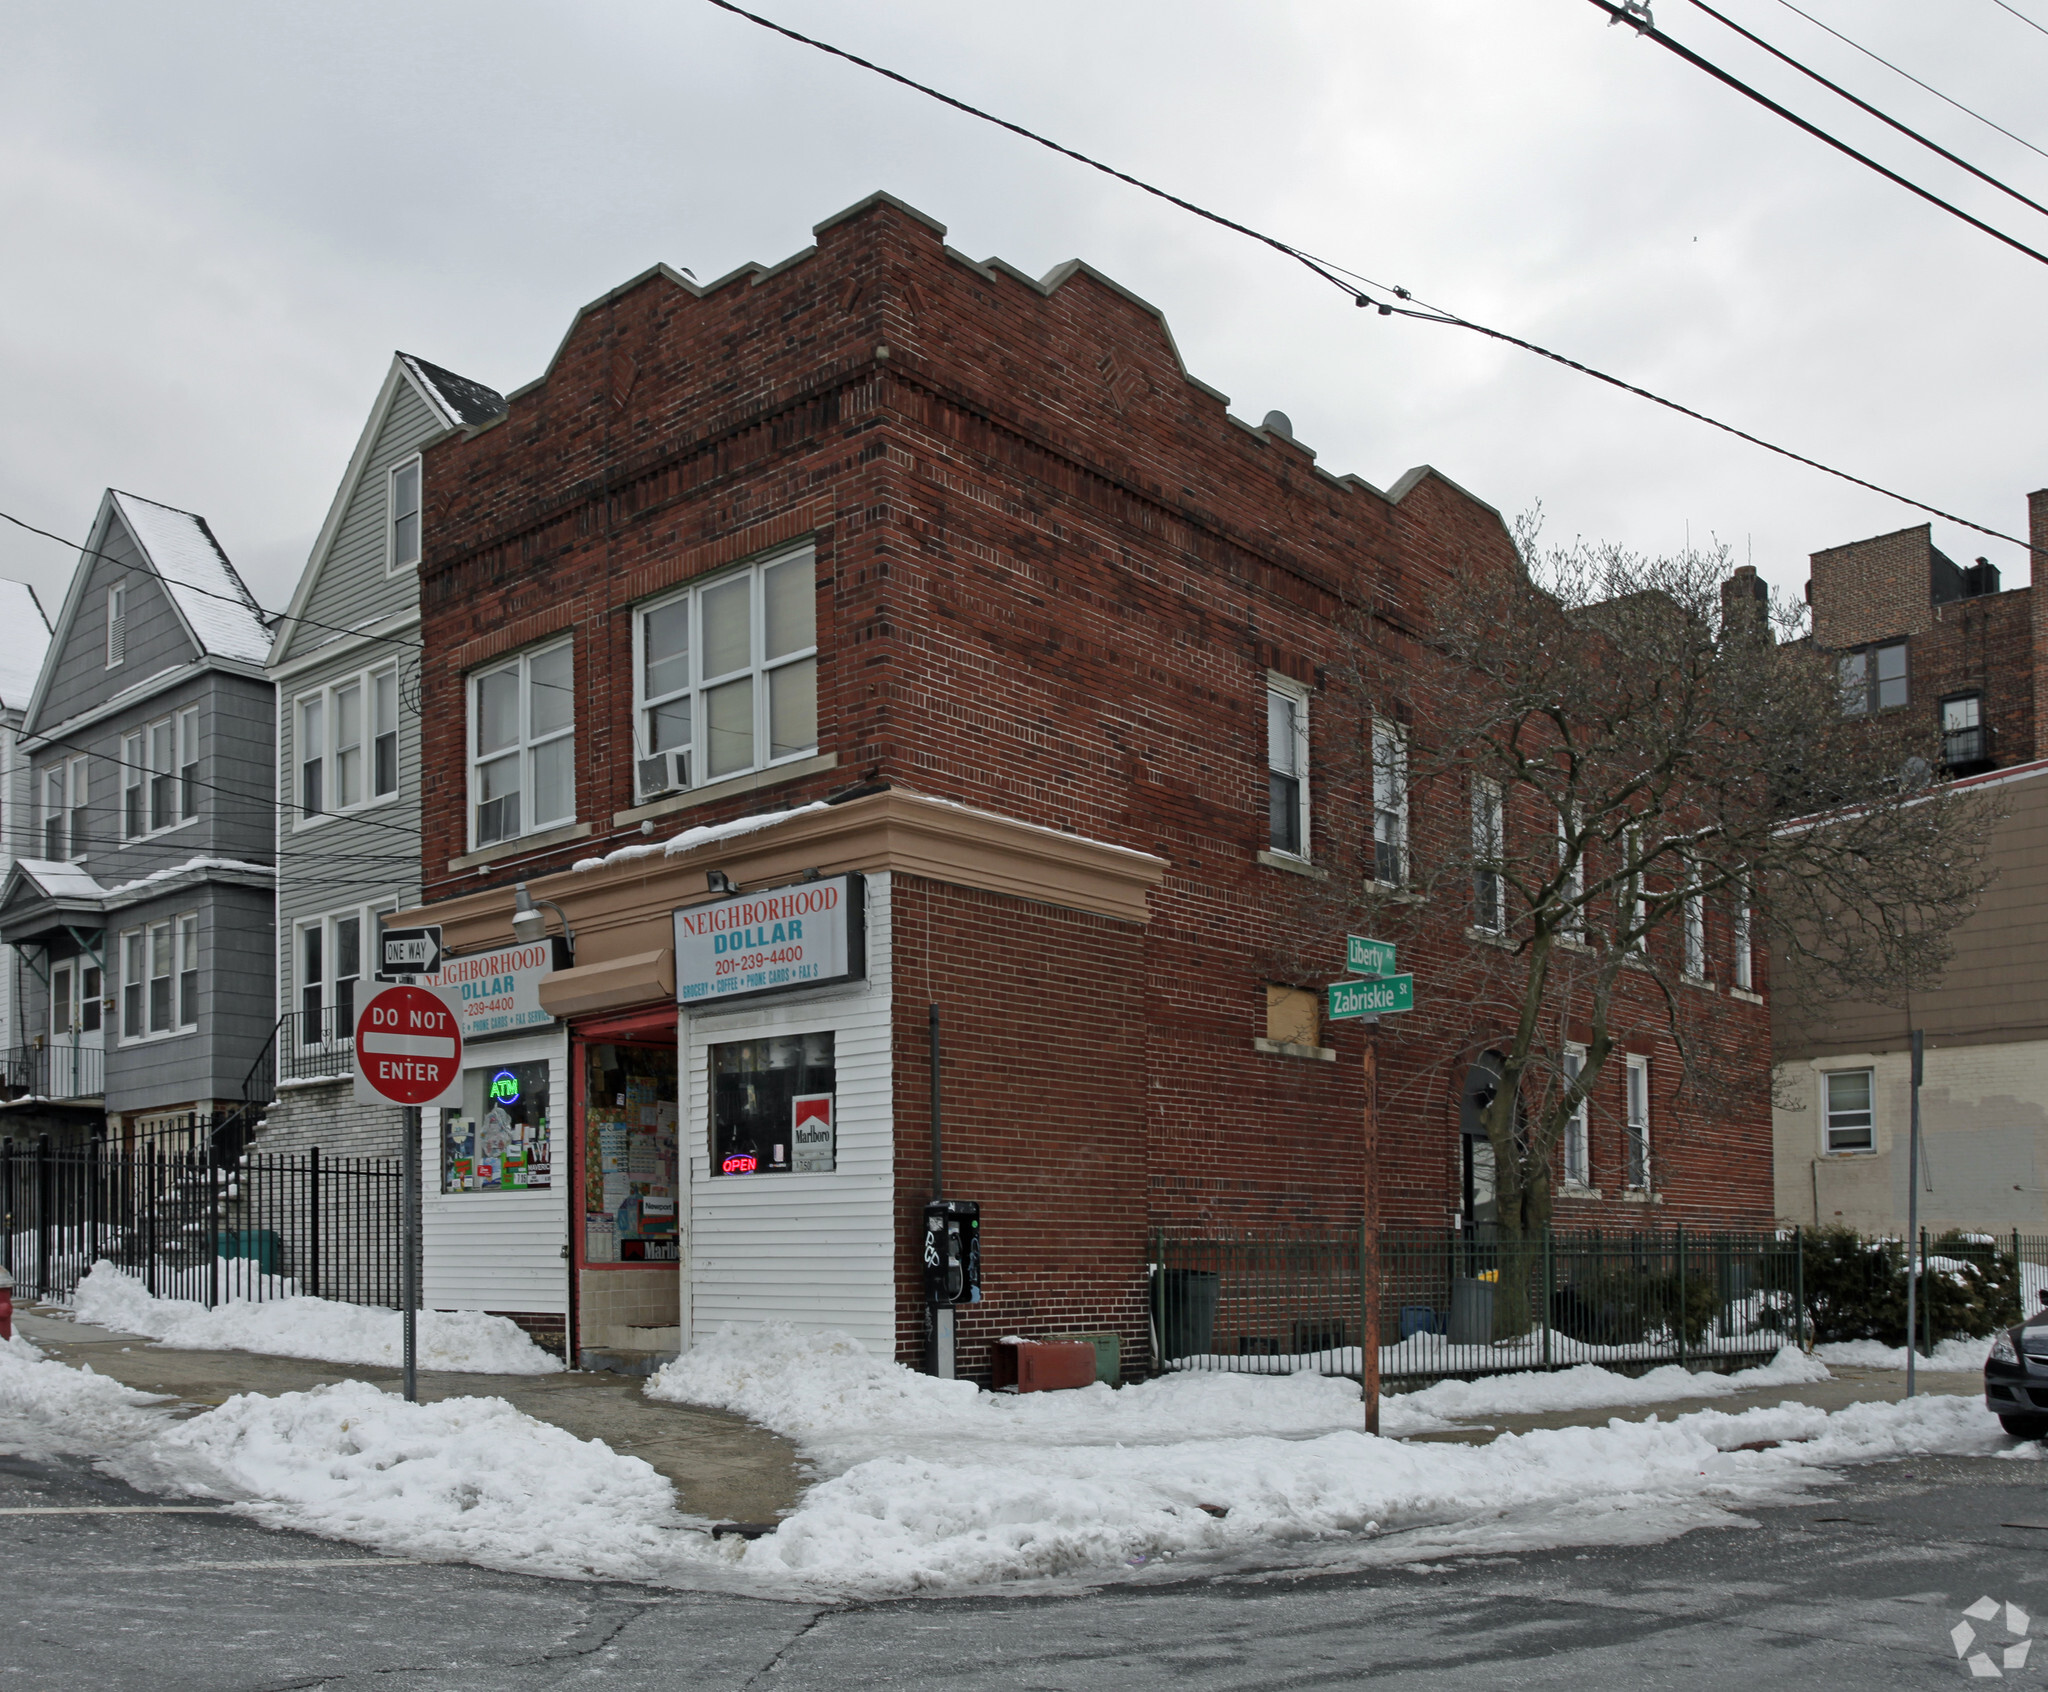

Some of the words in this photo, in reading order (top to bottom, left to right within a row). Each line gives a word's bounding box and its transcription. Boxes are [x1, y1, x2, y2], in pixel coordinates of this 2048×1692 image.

[683, 886, 838, 938] NEIGHBORHOOD
[714, 919, 803, 955] DOLLAR
[387, 943, 405, 961] ONE
[408, 941, 427, 960] WAY
[715, 945, 803, 976] 201-239-4400
[1350, 940, 1383, 974] Liberty
[424, 946, 546, 987] NEIGHBORHOOD
[454, 975, 515, 1001] OLLAR
[683, 981, 709, 999] GROCERY
[717, 976, 738, 993] COFFEE
[746, 971, 767, 988] PHONE
[768, 967, 790, 984] CARDS
[799, 964, 811, 979] FAX
[1334, 984, 1394, 1014] Zabriskie
[1399, 983, 1407, 995] St
[372, 1007, 399, 1027] DO
[410, 1010, 447, 1030] NOT
[473, 1019, 490, 1033] PHONE
[515, 1012, 527, 1025] FAX
[379, 1061, 439, 1082] ENTER
[490, 1078, 518, 1098] ATM
[795, 1125, 830, 1144] Marlboro
[722, 1157, 757, 1173] OPEN
[645, 1202, 672, 1211] Newport
